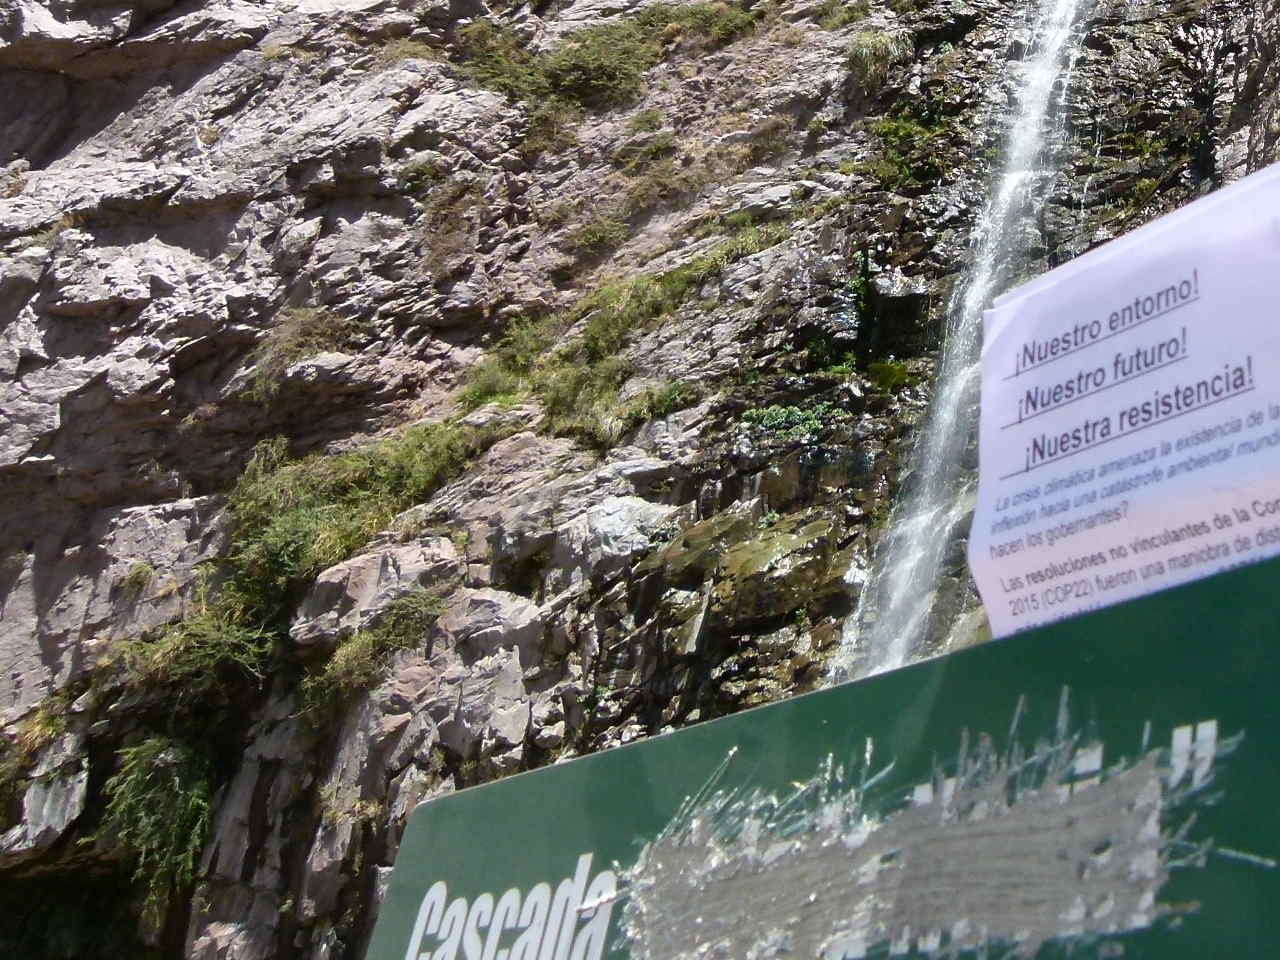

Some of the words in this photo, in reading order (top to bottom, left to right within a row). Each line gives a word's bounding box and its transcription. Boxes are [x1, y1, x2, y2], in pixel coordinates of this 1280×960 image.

[1015, 319, 1101, 376] ¡Nuestro
[1109, 269, 1199, 330] entorno!
[1018, 367, 1105, 424] ¡Nuestro
[1113, 327, 1187, 379] futuro!
[1025, 412, 1111, 472] ¡Nuestra
[1119, 356, 1253, 431] resistencia!
[1175, 419, 1243, 452] existencia
[1247, 410, 1265, 429] de
[1268, 403, 1280, 421] la
[1000, 571, 1025, 594] Las
[1025, 547, 1107, 587] resoluciones
[1109, 541, 1129, 560] no
[1129, 519, 1212, 555] vinculantes
[1213, 512, 1234, 531] de
[1232, 507, 1252, 524] la
[1008, 595, 1040, 617] 2015
[1095, 566, 1139, 595] fueron
[1139, 560, 1166, 581] una
[1167, 540, 1231, 570] maniobra
[1233, 533, 1254, 552] de
[402, 851, 618, 960] Cascada
